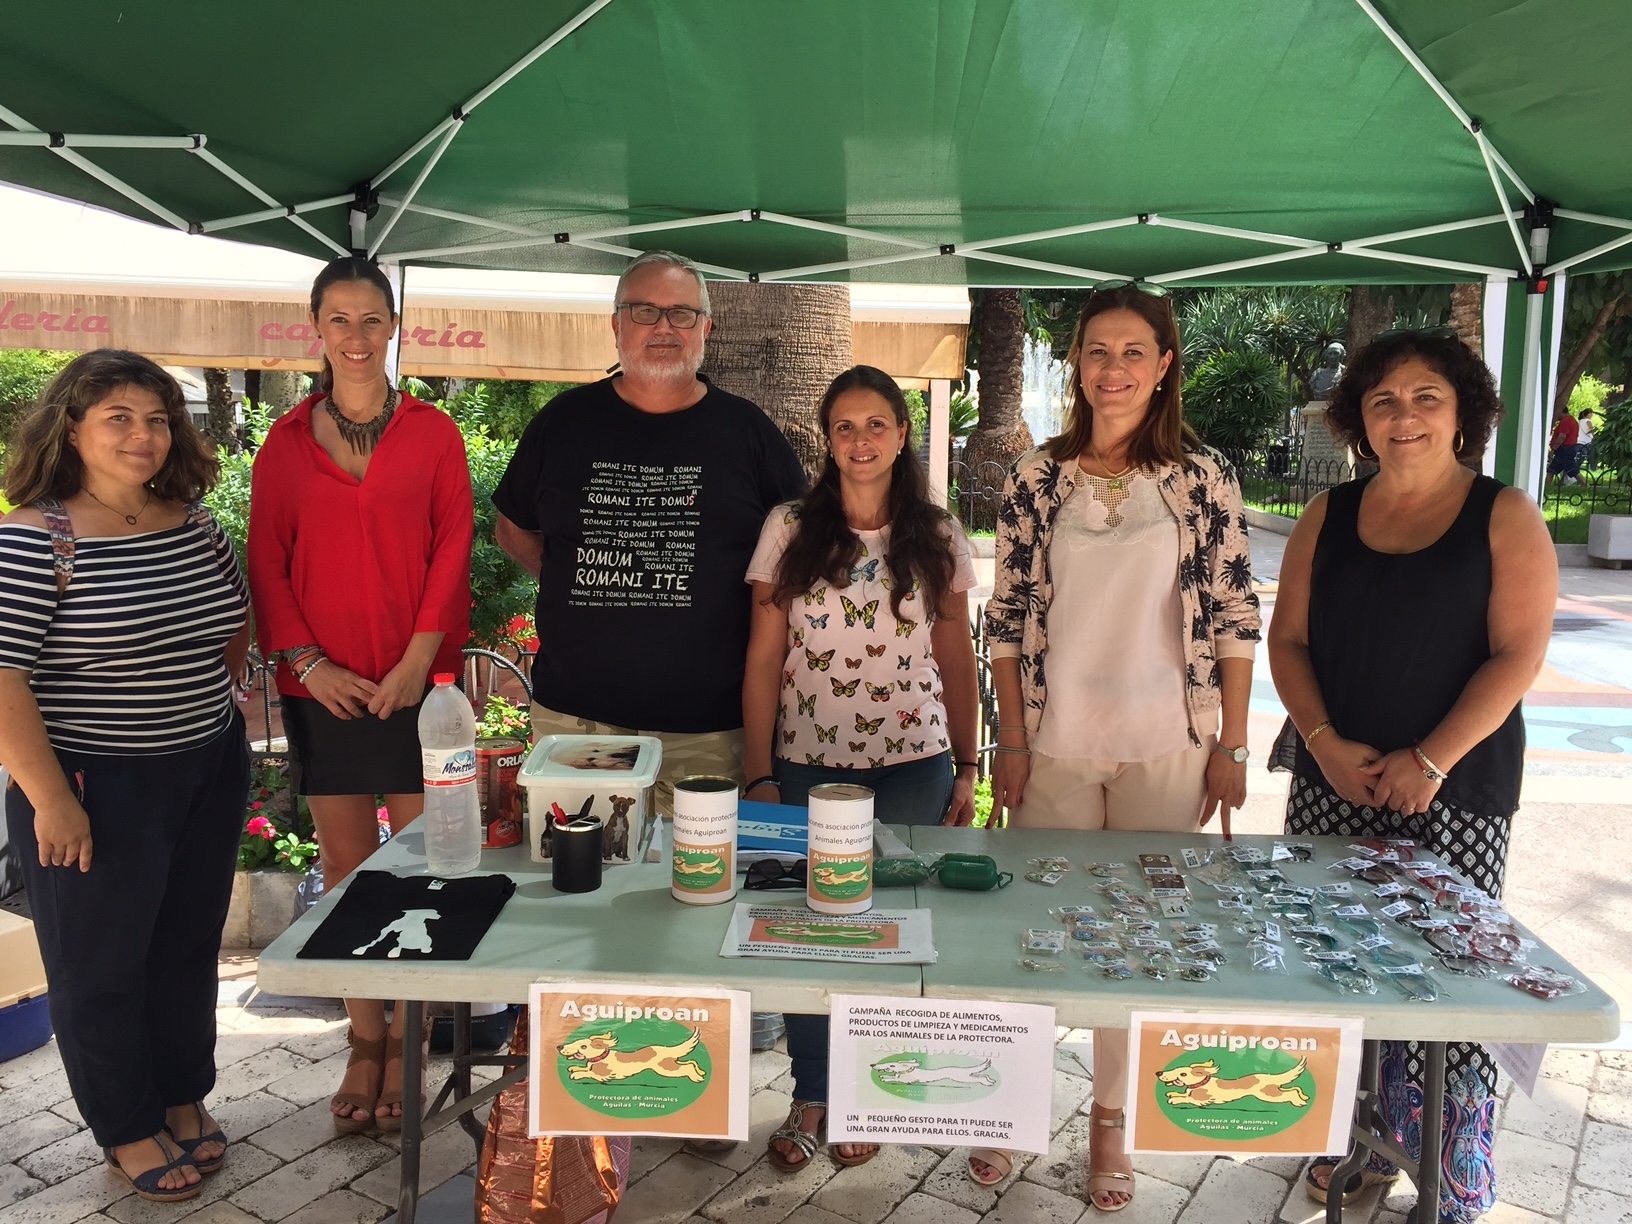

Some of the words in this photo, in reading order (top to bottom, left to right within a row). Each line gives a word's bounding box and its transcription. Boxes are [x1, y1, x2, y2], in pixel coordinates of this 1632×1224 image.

[592, 462, 620, 470] ROMANI
[622, 464, 637, 472] ITE
[640, 466, 664, 474] DOMUM
[588, 492, 631, 506] ROMANI
[635, 497, 656, 506] ITE
[612, 538, 627, 547] ITE
[629, 540, 655, 548] DOMUM
[665, 542, 696, 550] ROMANI
[577, 547, 632, 567] DOMUM
[644, 562, 675, 571] ROMANI
[576, 568, 644, 587] ROMANI
[652, 573, 689, 590] ITE
[496, 754, 523, 767] ORLA
[678, 813, 709, 822] asociación
[694, 828, 727, 837] Aguiproan
[815, 834, 843, 844] Animales
[813, 853, 870, 864] Aguiproan
[560, 1000, 709, 1023] Aguiproan
[849, 1006, 891, 1016] CAMPAÑA
[895, 1009, 938, 1018] RECOGIDA
[939, 1011, 950, 1019] DE
[952, 1012, 1003, 1023] ALIMENTOS,
[849, 1018, 899, 1027] PRODUCTOS
[914, 1021, 951, 1030] LIMPIEZA
[960, 1023, 1028, 1034] MEDICAMENTOS
[849, 1029, 871, 1037] PARA
[890, 1031, 932, 1040] ANIMALES
[958, 1034, 1015, 1044] PROTECTORA.
[1160, 1030, 1318, 1052] Aguiproan
[867, 1113, 906, 1124] PEQUEÑO
[908, 1116, 935, 1124] GESTO
[936, 1117, 958, 1125] PARA
[970, 1119, 996, 1128] PUEDE
[998, 1121, 1013, 1129] SER
[866, 1126, 890, 1134] GRAN
[892, 1127, 920, 1135] AYUDA
[946, 1129, 972, 1137] ELLOS.
[974, 1130, 1011, 1139] GRACIAS.
